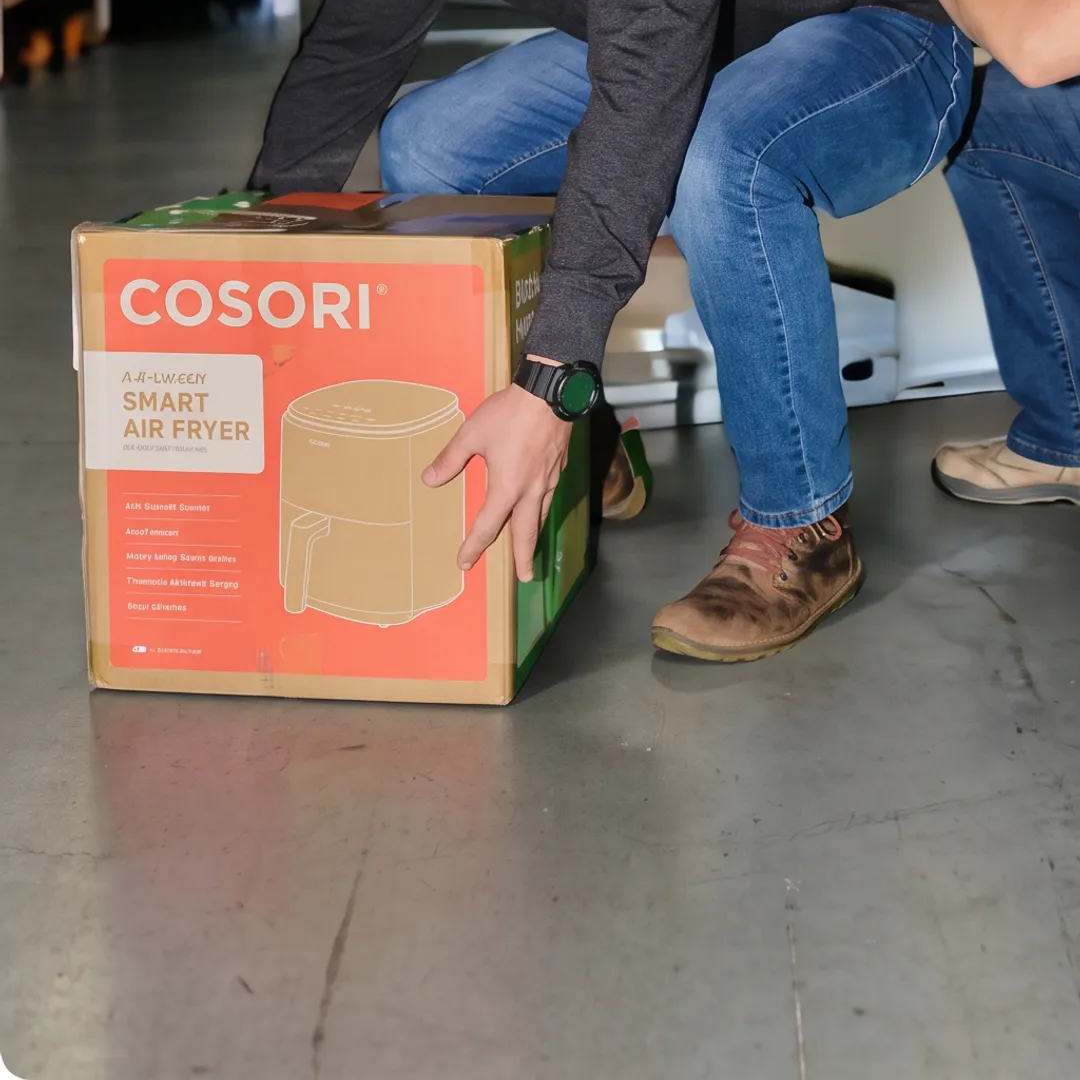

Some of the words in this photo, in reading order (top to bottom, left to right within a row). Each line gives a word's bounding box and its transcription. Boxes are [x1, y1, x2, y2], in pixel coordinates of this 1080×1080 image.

[122, 391, 210, 413] SMART
[123, 418, 165, 439] AIR
[172, 419, 250, 441] FRYER
